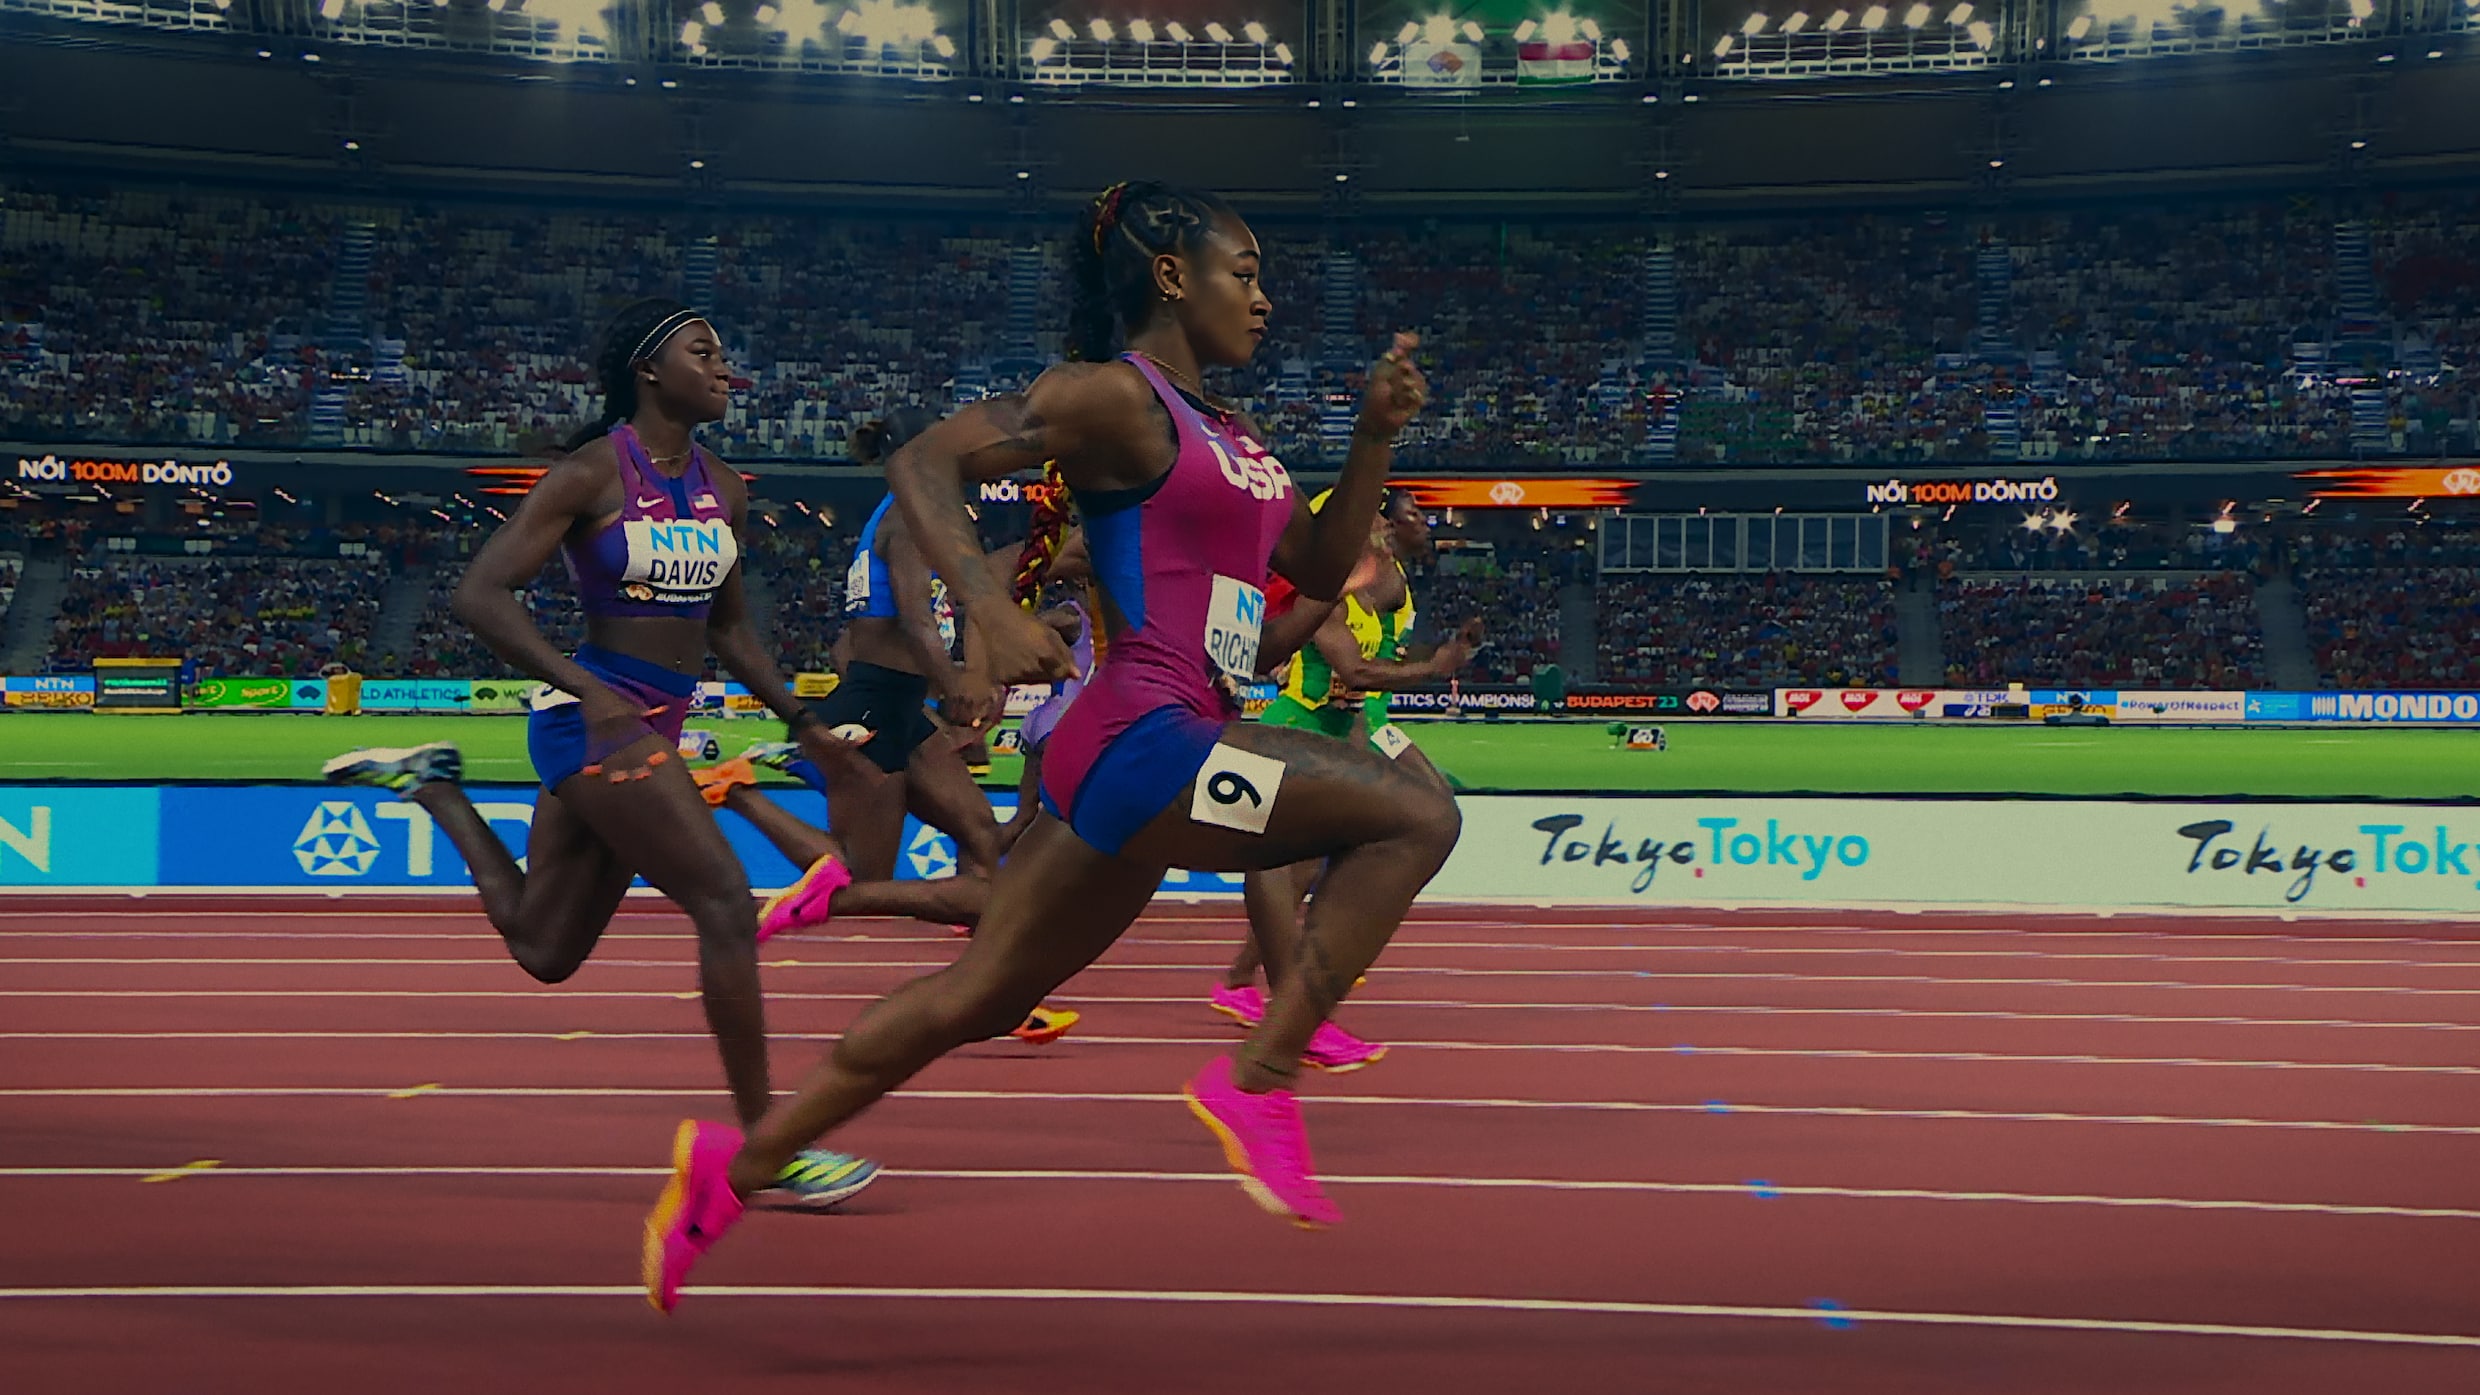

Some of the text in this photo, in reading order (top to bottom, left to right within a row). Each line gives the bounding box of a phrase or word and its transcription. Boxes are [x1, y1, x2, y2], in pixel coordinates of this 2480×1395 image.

[70, 460, 139, 482] 100M
[1911, 482, 1972, 502] 100M
[650, 526, 719, 554] NTN
[647, 559, 719, 586] DAVIS
[35, 678, 75, 690] NTN
[1437, 693, 1537, 708] CAMPIONS
[1566, 695, 1680, 709] BUDAPEST 23
[2056, 691, 2092, 703] NN
[2338, 694, 2479, 719] MONDO
[1207, 770, 1262, 809] 9
[1531, 814, 1869, 893] Tokyo Tokyo
[2177, 820, 2480, 902] Tokyo Tok
